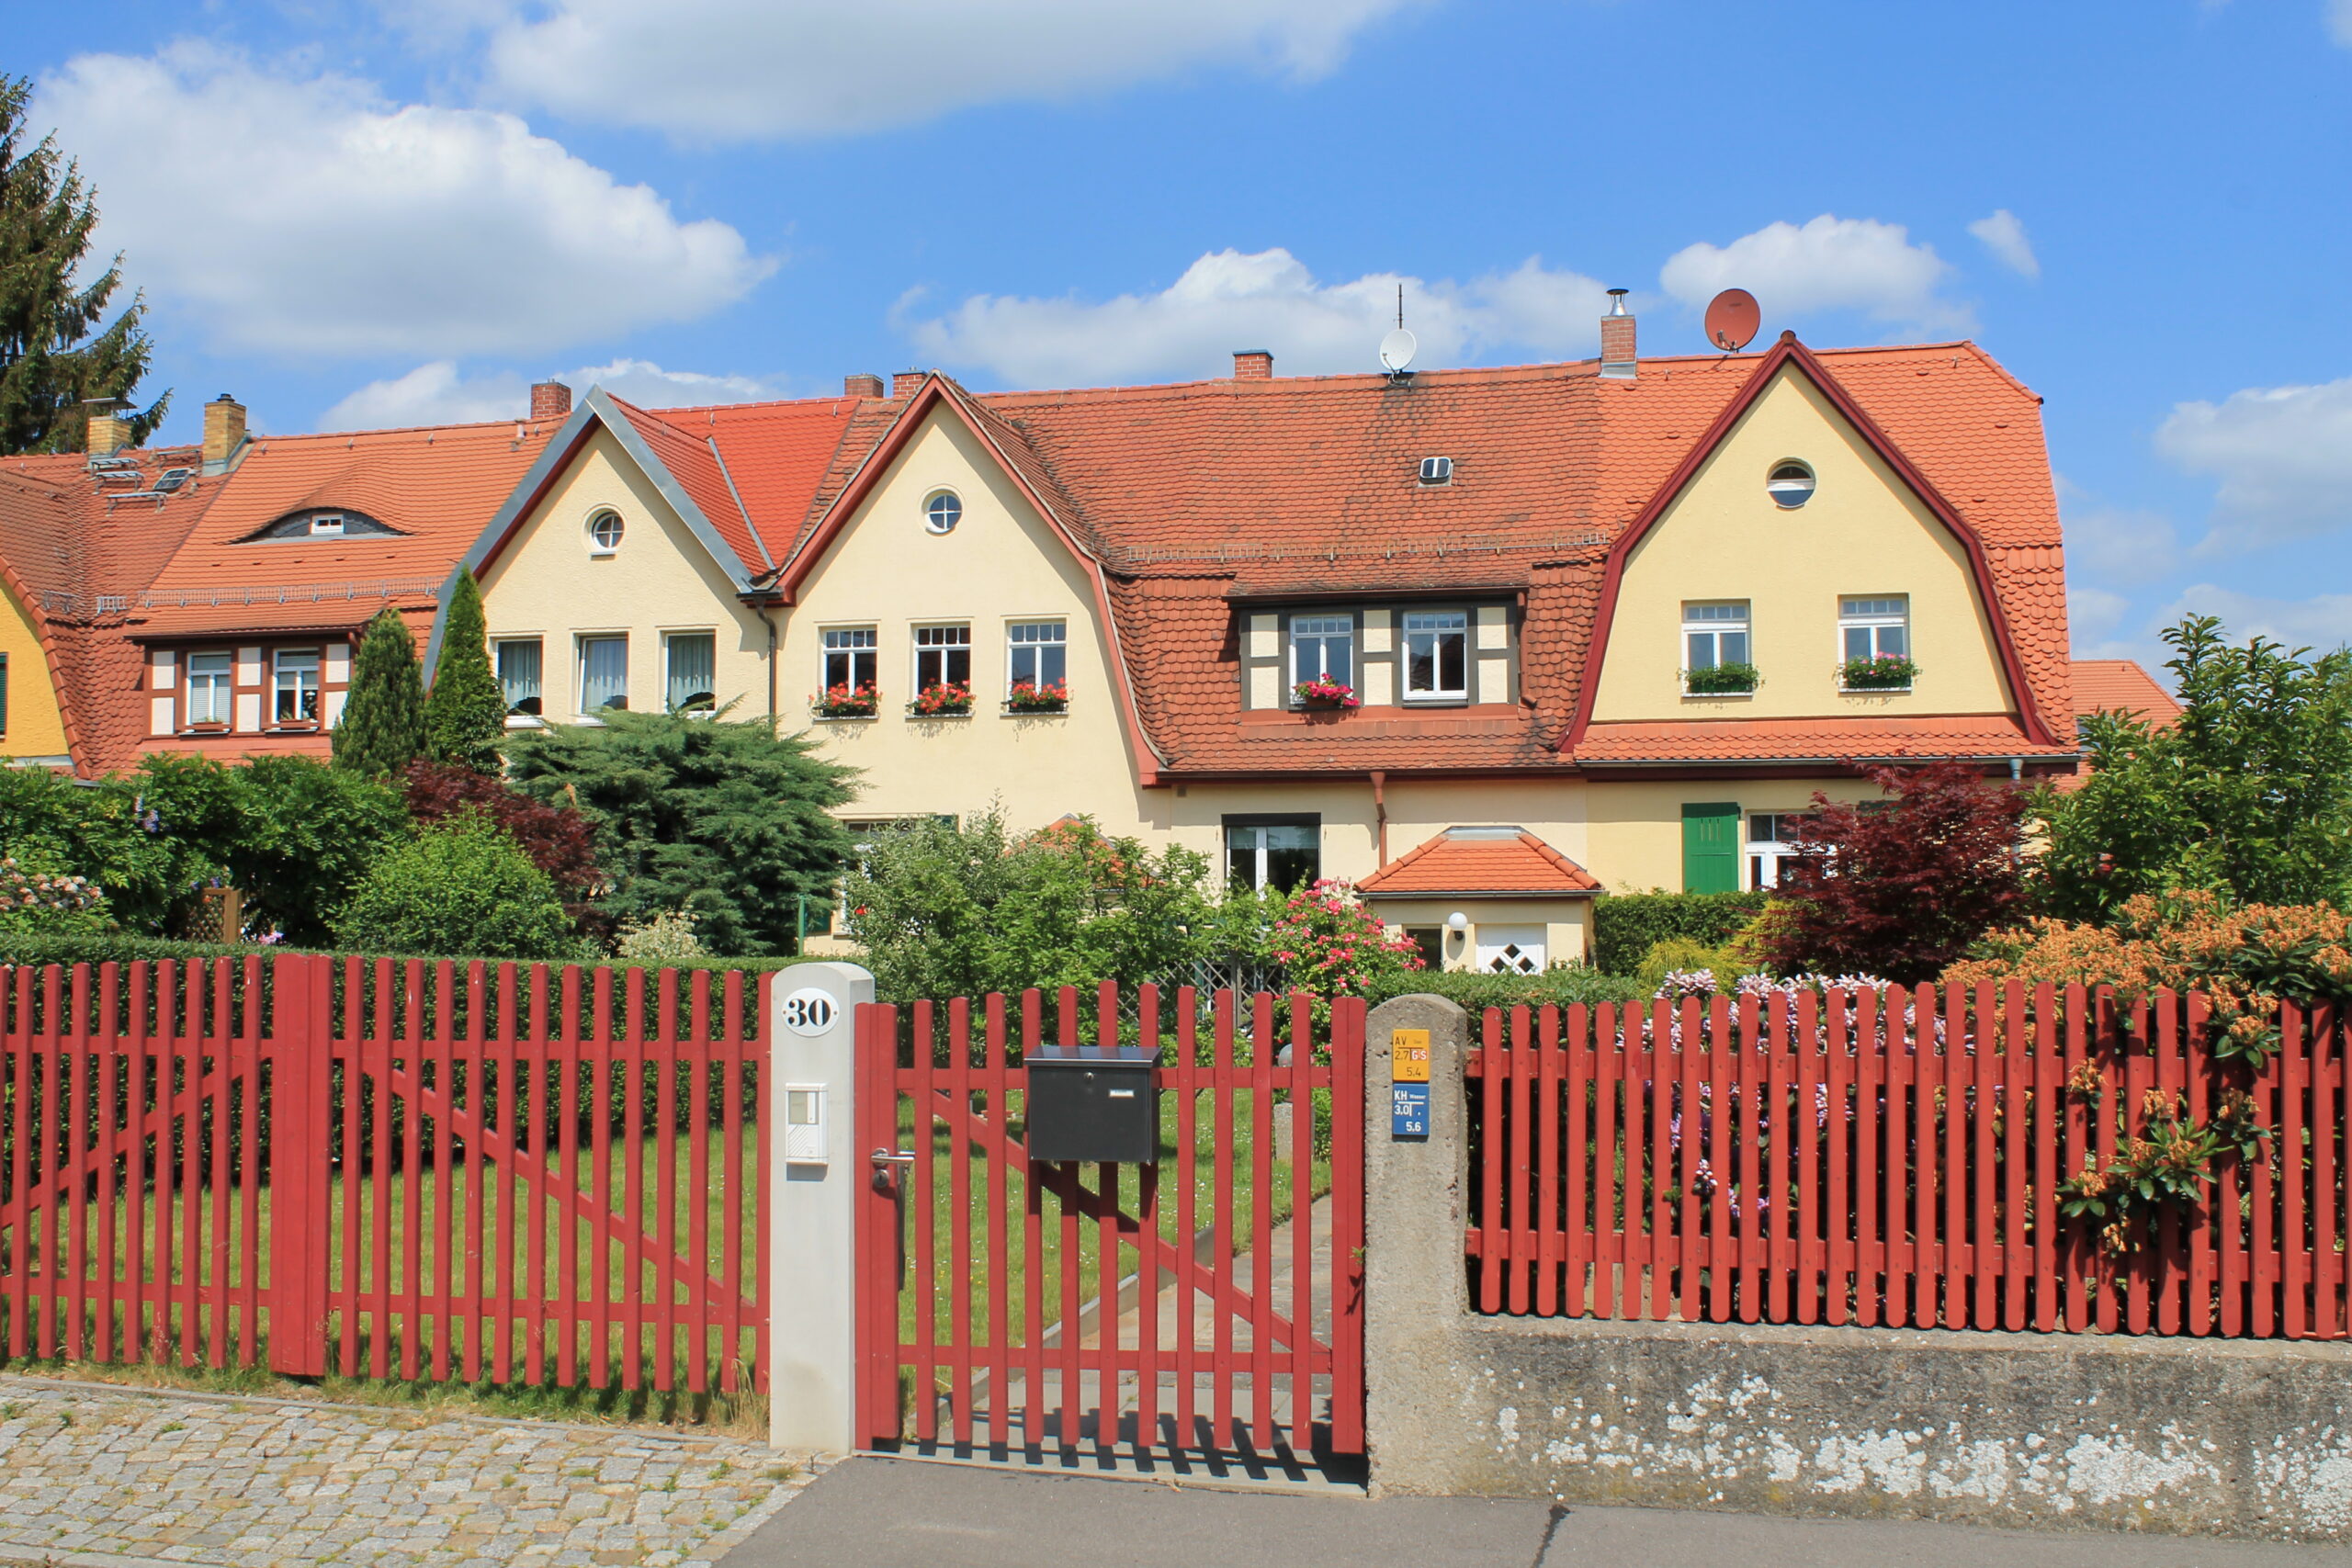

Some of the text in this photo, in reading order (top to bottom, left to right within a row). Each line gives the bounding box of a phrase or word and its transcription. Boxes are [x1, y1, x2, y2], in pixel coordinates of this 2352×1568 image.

[787, 998, 831, 1027] 30
[1395, 1036, 1407, 1045] AV
[1395, 1051, 1408, 1060] 2.7
[1407, 1067, 1421, 1077] 5.4
[1394, 1090, 1408, 1100] KH
[1394, 1105, 1408, 1115] 3.0
[1406, 1122, 1421, 1132] 5.6
